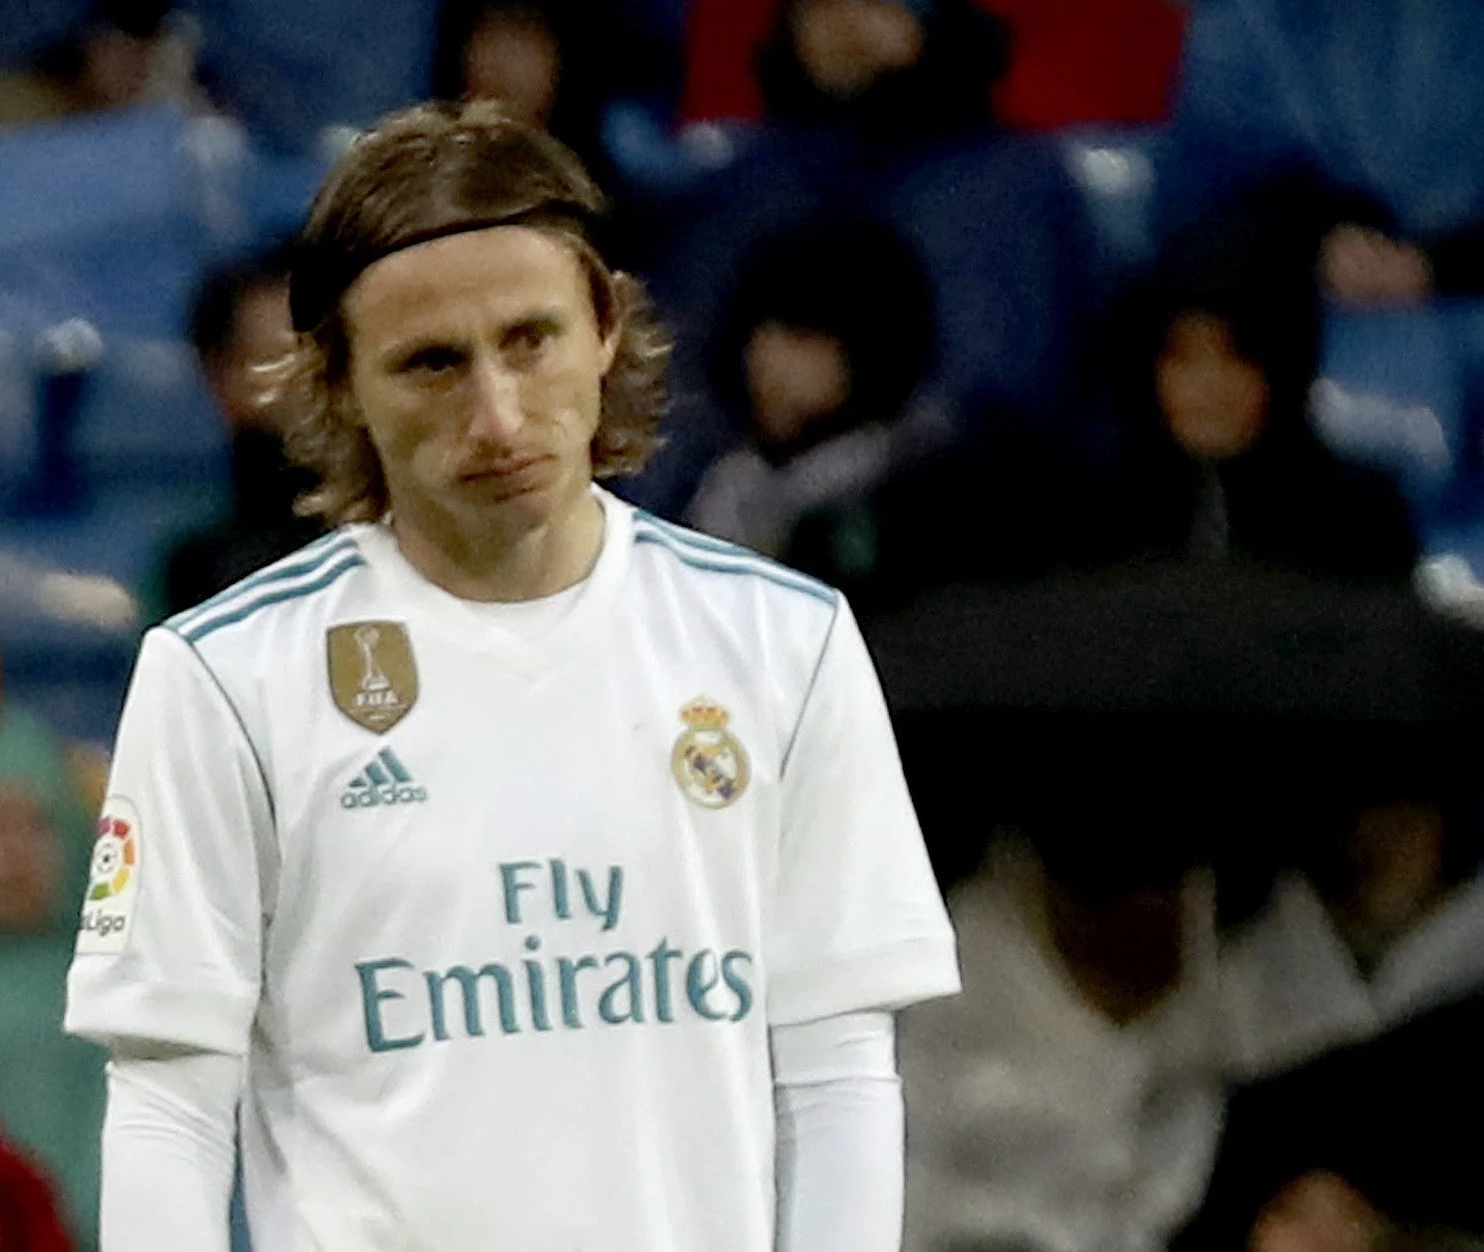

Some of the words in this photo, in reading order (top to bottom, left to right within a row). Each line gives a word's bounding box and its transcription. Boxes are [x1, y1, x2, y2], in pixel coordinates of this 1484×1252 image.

[340, 780, 428, 809] adidas
[497, 856, 623, 933] Fly
[354, 934, 753, 1054] Emirates
